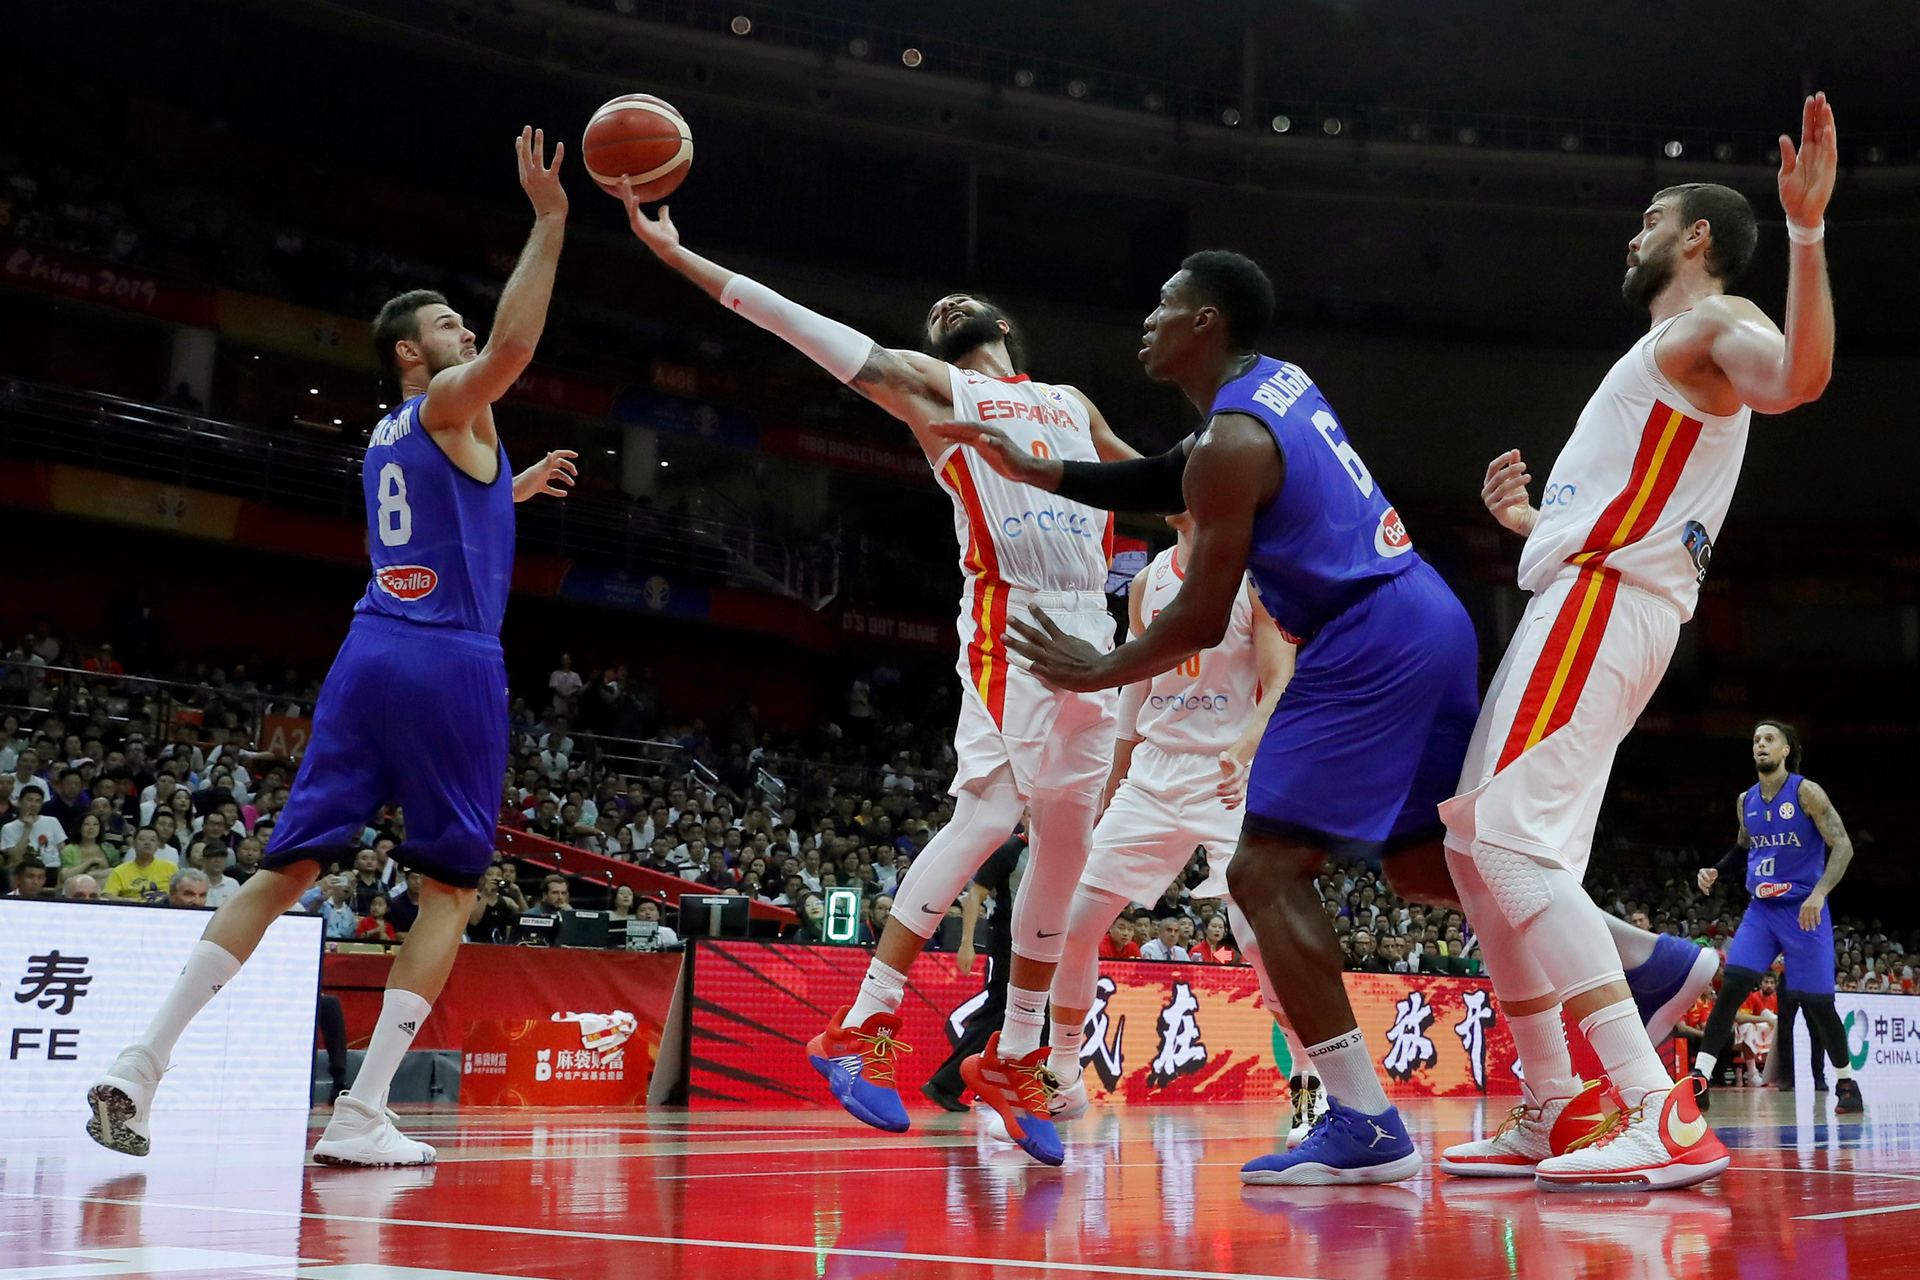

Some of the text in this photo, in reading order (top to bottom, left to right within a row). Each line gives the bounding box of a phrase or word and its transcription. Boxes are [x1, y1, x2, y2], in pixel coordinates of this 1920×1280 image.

[5, 247, 157, 304] China 2019
[1311, 409, 1374, 499] 6
[377, 462, 413, 547] 8
[827, 891, 857, 941] 0
[14, 950, 93, 1016] 寿
[9, 1028, 80, 1061] FE
[1875, 1014, 1920, 1044] 中国人
[1875, 1049, 1912, 1065] CHINA
